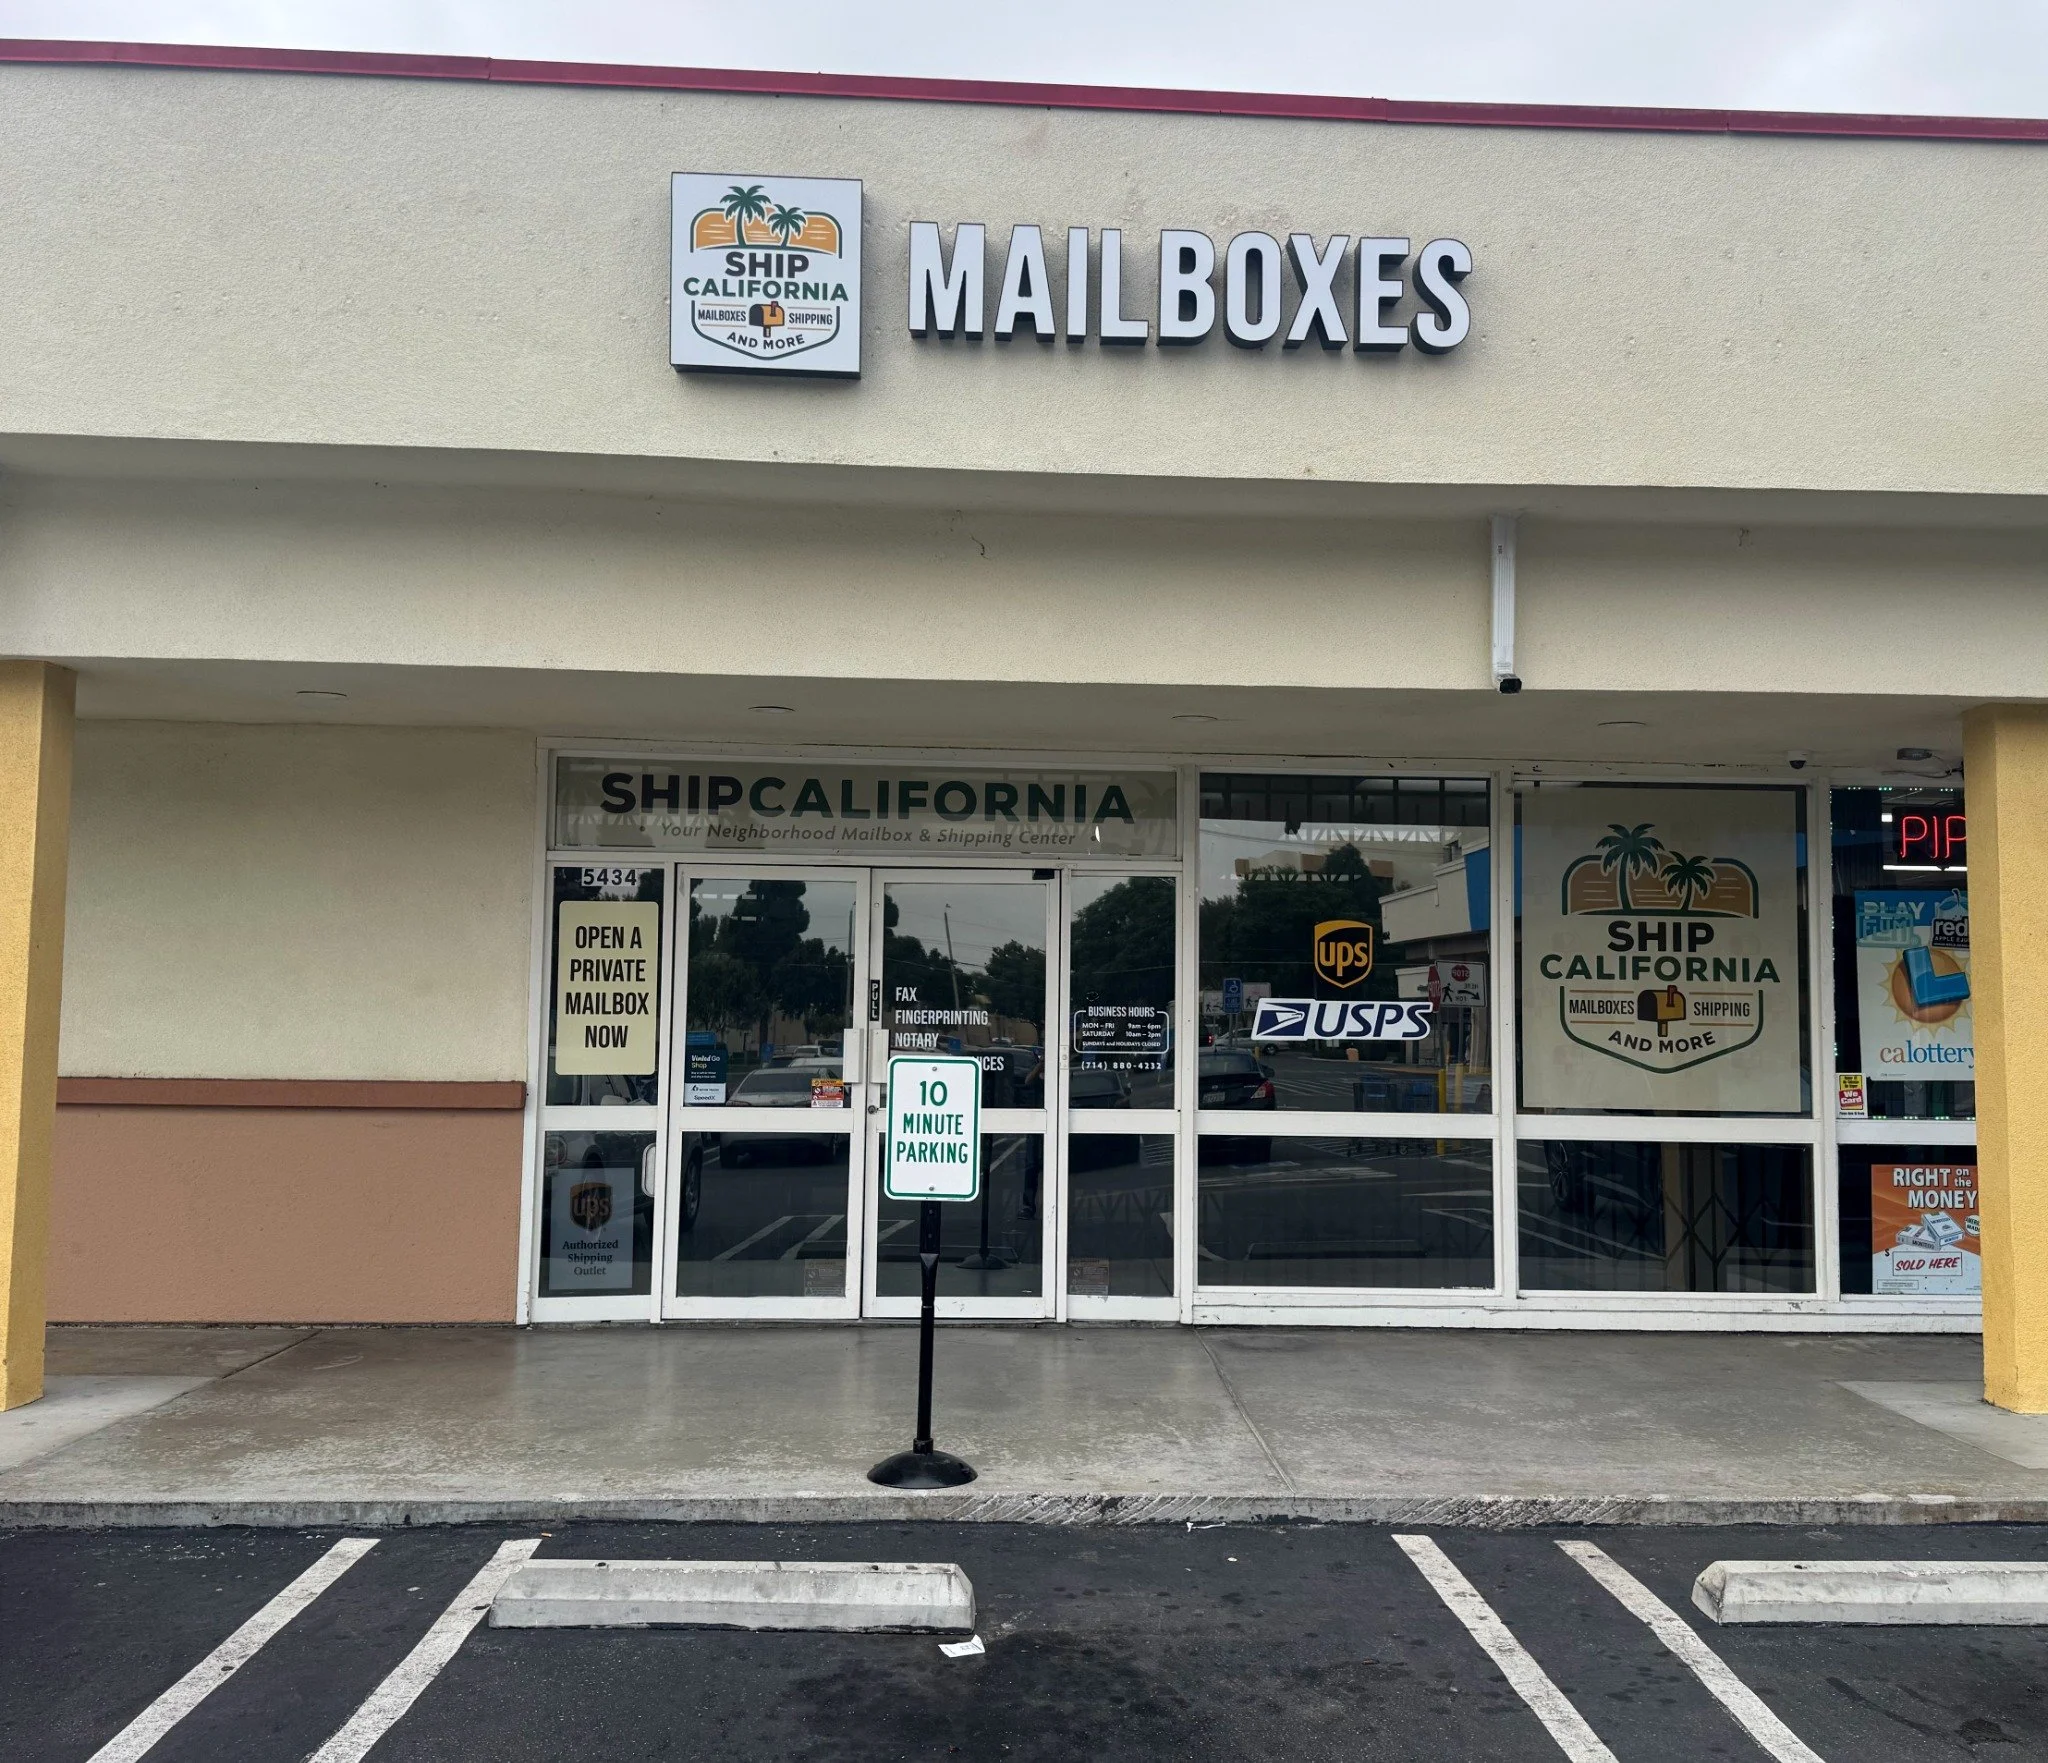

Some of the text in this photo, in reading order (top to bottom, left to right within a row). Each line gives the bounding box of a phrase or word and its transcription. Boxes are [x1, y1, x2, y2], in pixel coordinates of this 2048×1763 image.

[725, 251, 809, 278] SHIP
[683, 277, 849, 301] CALIFORNIA
[909, 221, 1473, 352] MAILBOXES
[698, 309, 833, 326] MAILBOXES SHIPPING
[727, 331, 805, 350] AND MORE
[661, 823, 1076, 847] Your Neighborhood Mailbox & Shipping Center
[583, 868, 638, 886] 5434
[1863, 901, 1926, 919] PLAY
[575, 925, 643, 949] OPEN A
[1607, 920, 1715, 952] SHIP
[1319, 941, 1369, 977] ups
[1540, 953, 1781, 983] CALIFORNIA
[569, 958, 646, 982] PRIVATE
[565, 992, 650, 1015] MAILBOX
[871, 982, 879, 1019] PULL
[895, 986, 918, 1001] FAX
[895, 1010, 989, 1025] FINGERPRINTING
[1088, 1006, 1155, 1018] BUSINESS HOURS
[1569, 999, 1751, 1017] MAILBOXES SHIPPING
[1128, 1022, 1141, 1030] 9am
[1147, 1023, 1161, 1031] 6pm
[1314, 1003, 1432, 1038] USPS
[584, 1025, 628, 1048] NOW
[894, 1032, 940, 1047] NOTARY
[1608, 1030, 1716, 1054] AND MORE
[1081, 1061, 1162, 1070] (714) 880-4232
[919, 1080, 948, 1106] 10
[1840, 1096, 1862, 1105] Card
[1843, 1090, 1859, 1098] We
[903, 1113, 964, 1135] MINUTE
[896, 1141, 968, 1164] PARKING
[1893, 1167, 1970, 1187] RIGHT on
[1954, 1177, 1972, 1187] the
[1907, 1189, 1978, 1209] MONEY
[573, 1196, 611, 1225] ups
[562, 1240, 619, 1250] Authorized
[568, 1253, 613, 1265] Shipping
[1895, 1257, 1960, 1271] SOLD HERE
[574, 1266, 607, 1275] Outlet
